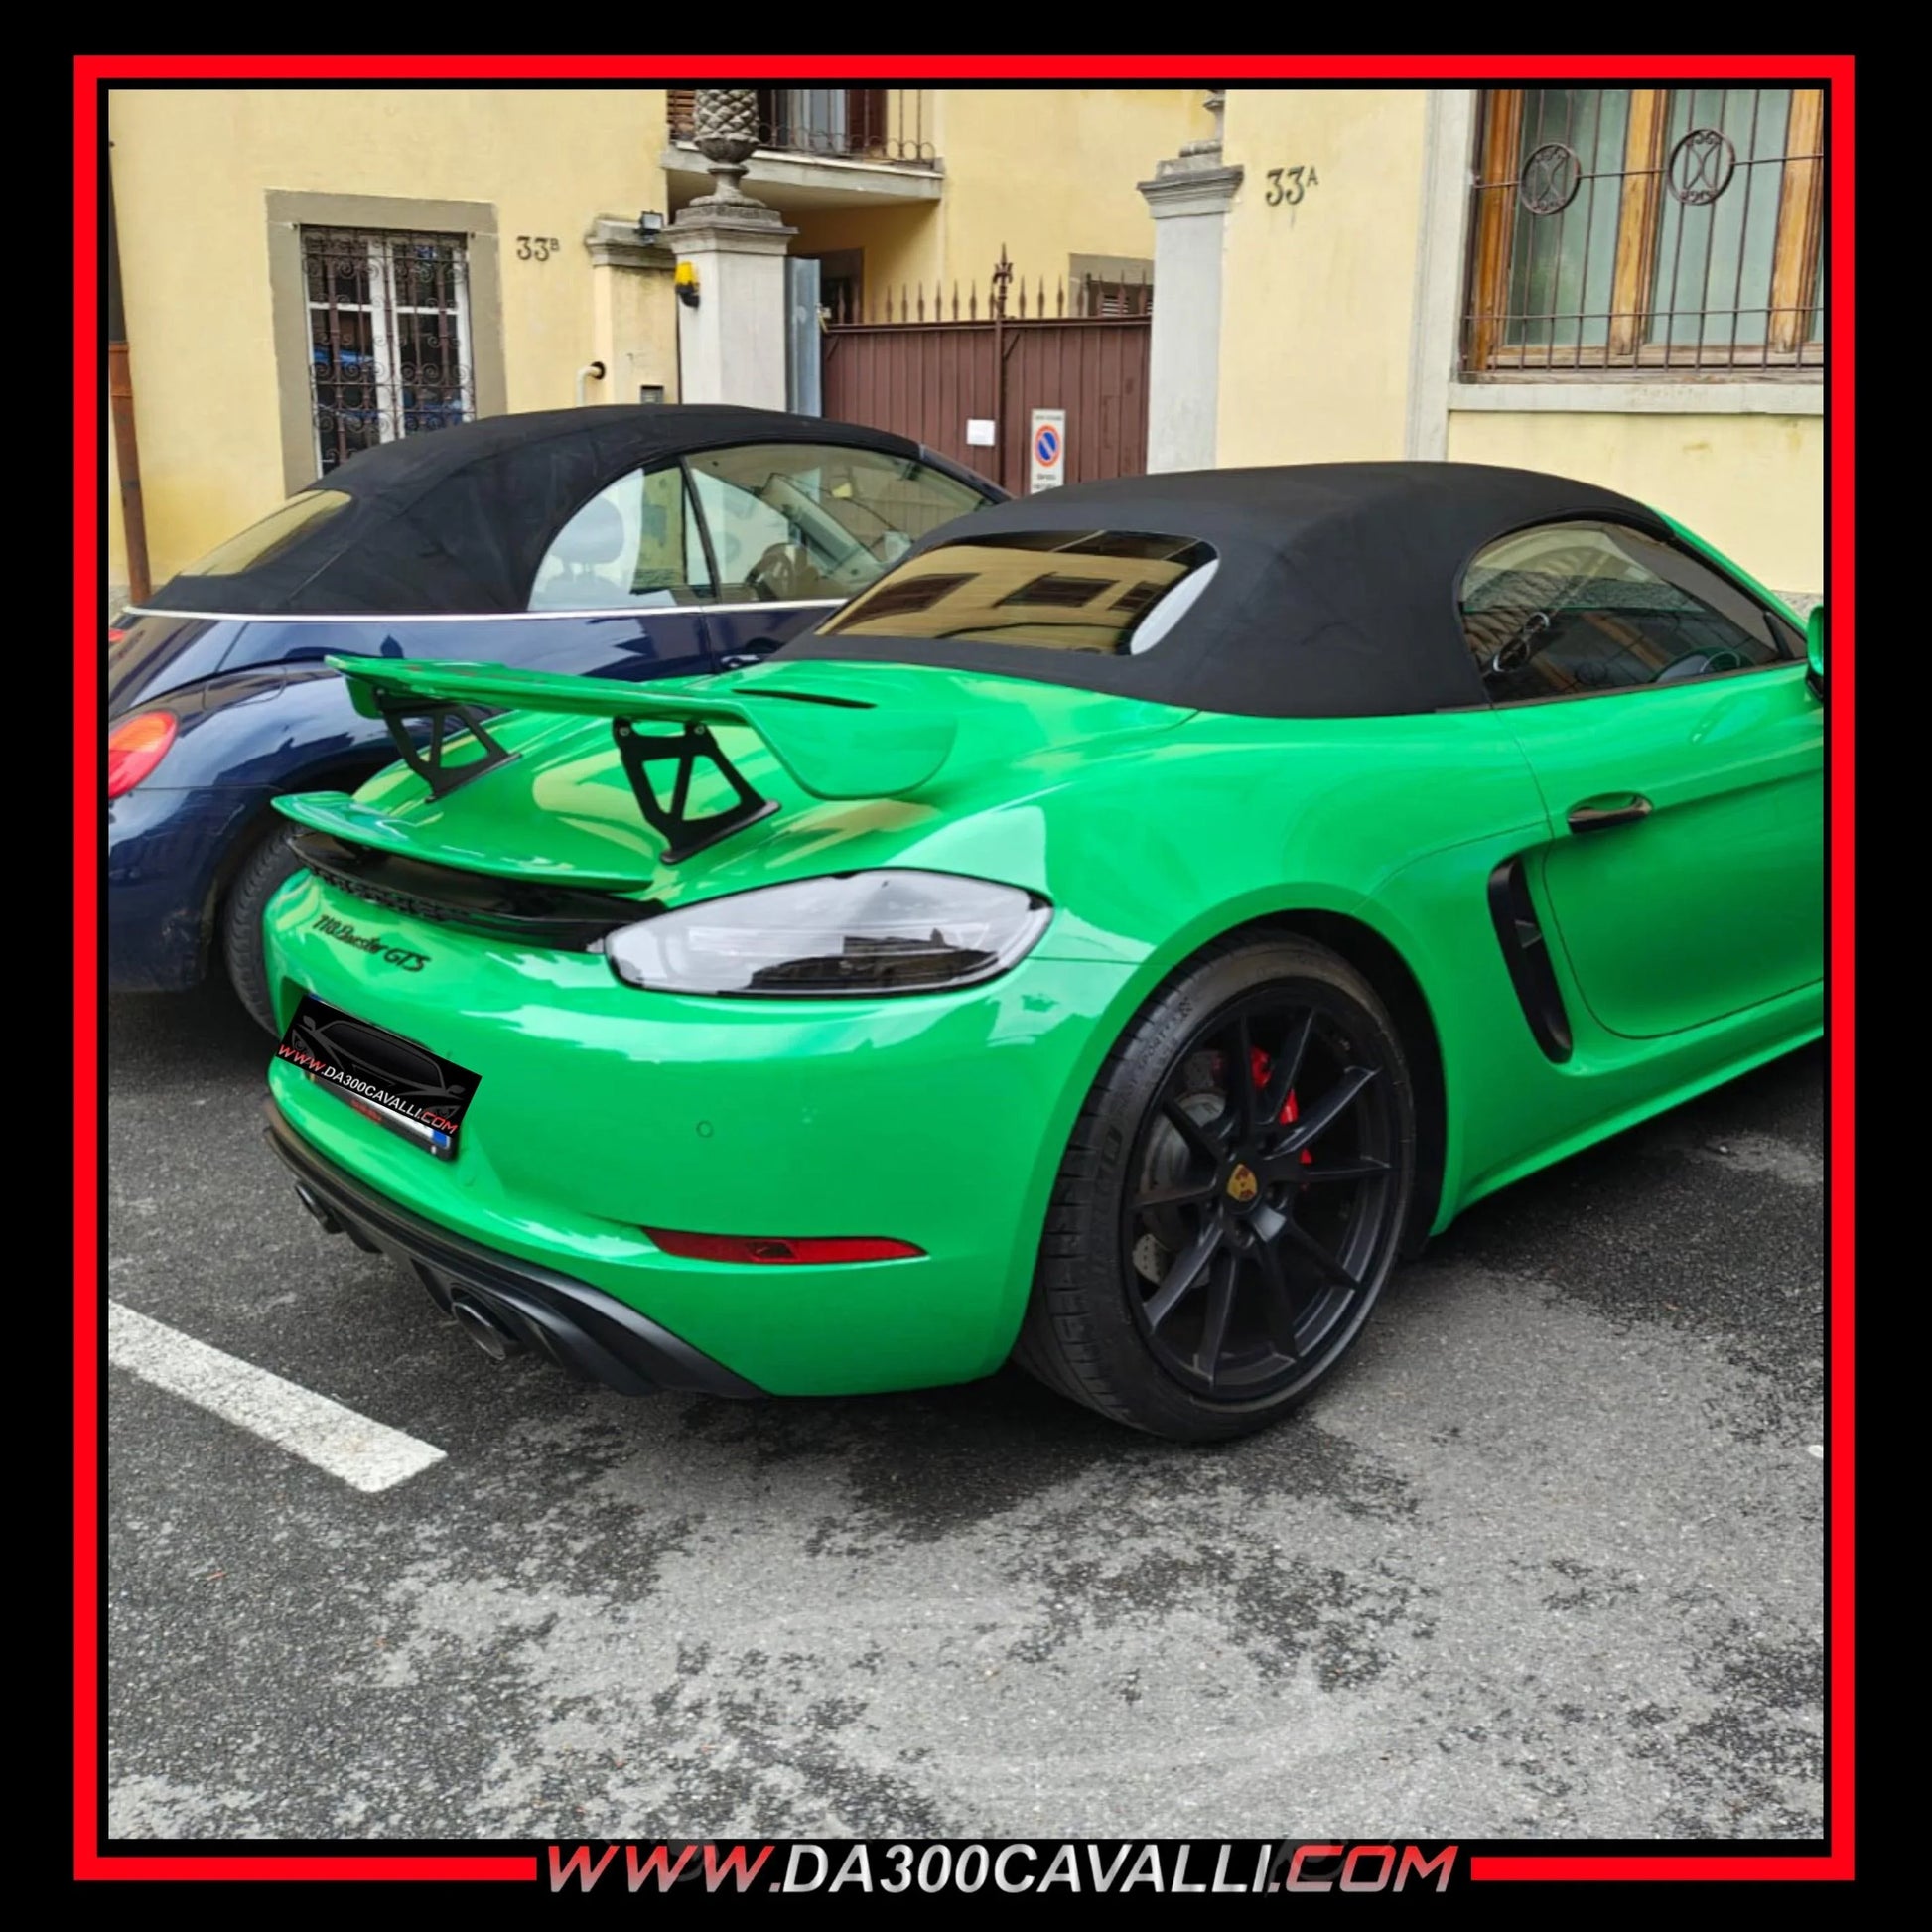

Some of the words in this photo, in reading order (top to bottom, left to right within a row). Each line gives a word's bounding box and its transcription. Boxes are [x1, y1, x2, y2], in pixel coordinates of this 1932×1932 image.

[1265, 165, 1319, 207] 33A
[515, 235, 560, 262] 33B
[383, 947, 432, 972] GTS
